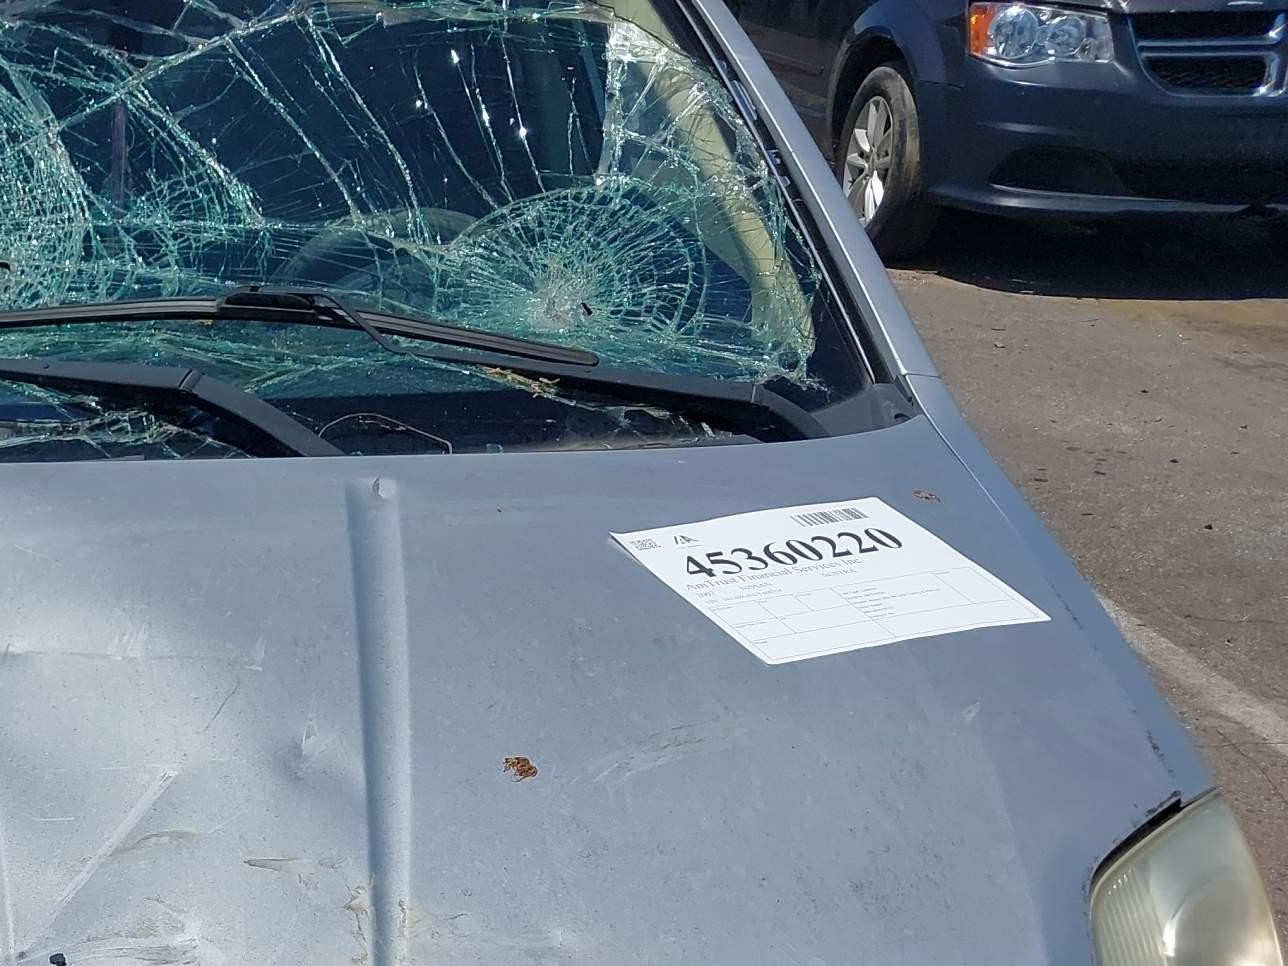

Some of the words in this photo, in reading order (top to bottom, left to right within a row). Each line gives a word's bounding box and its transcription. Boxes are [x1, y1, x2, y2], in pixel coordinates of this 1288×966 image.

[686, 527, 903, 578] 45360220
[737, 567, 793, 582] Financial
[792, 561, 843, 573] Services
